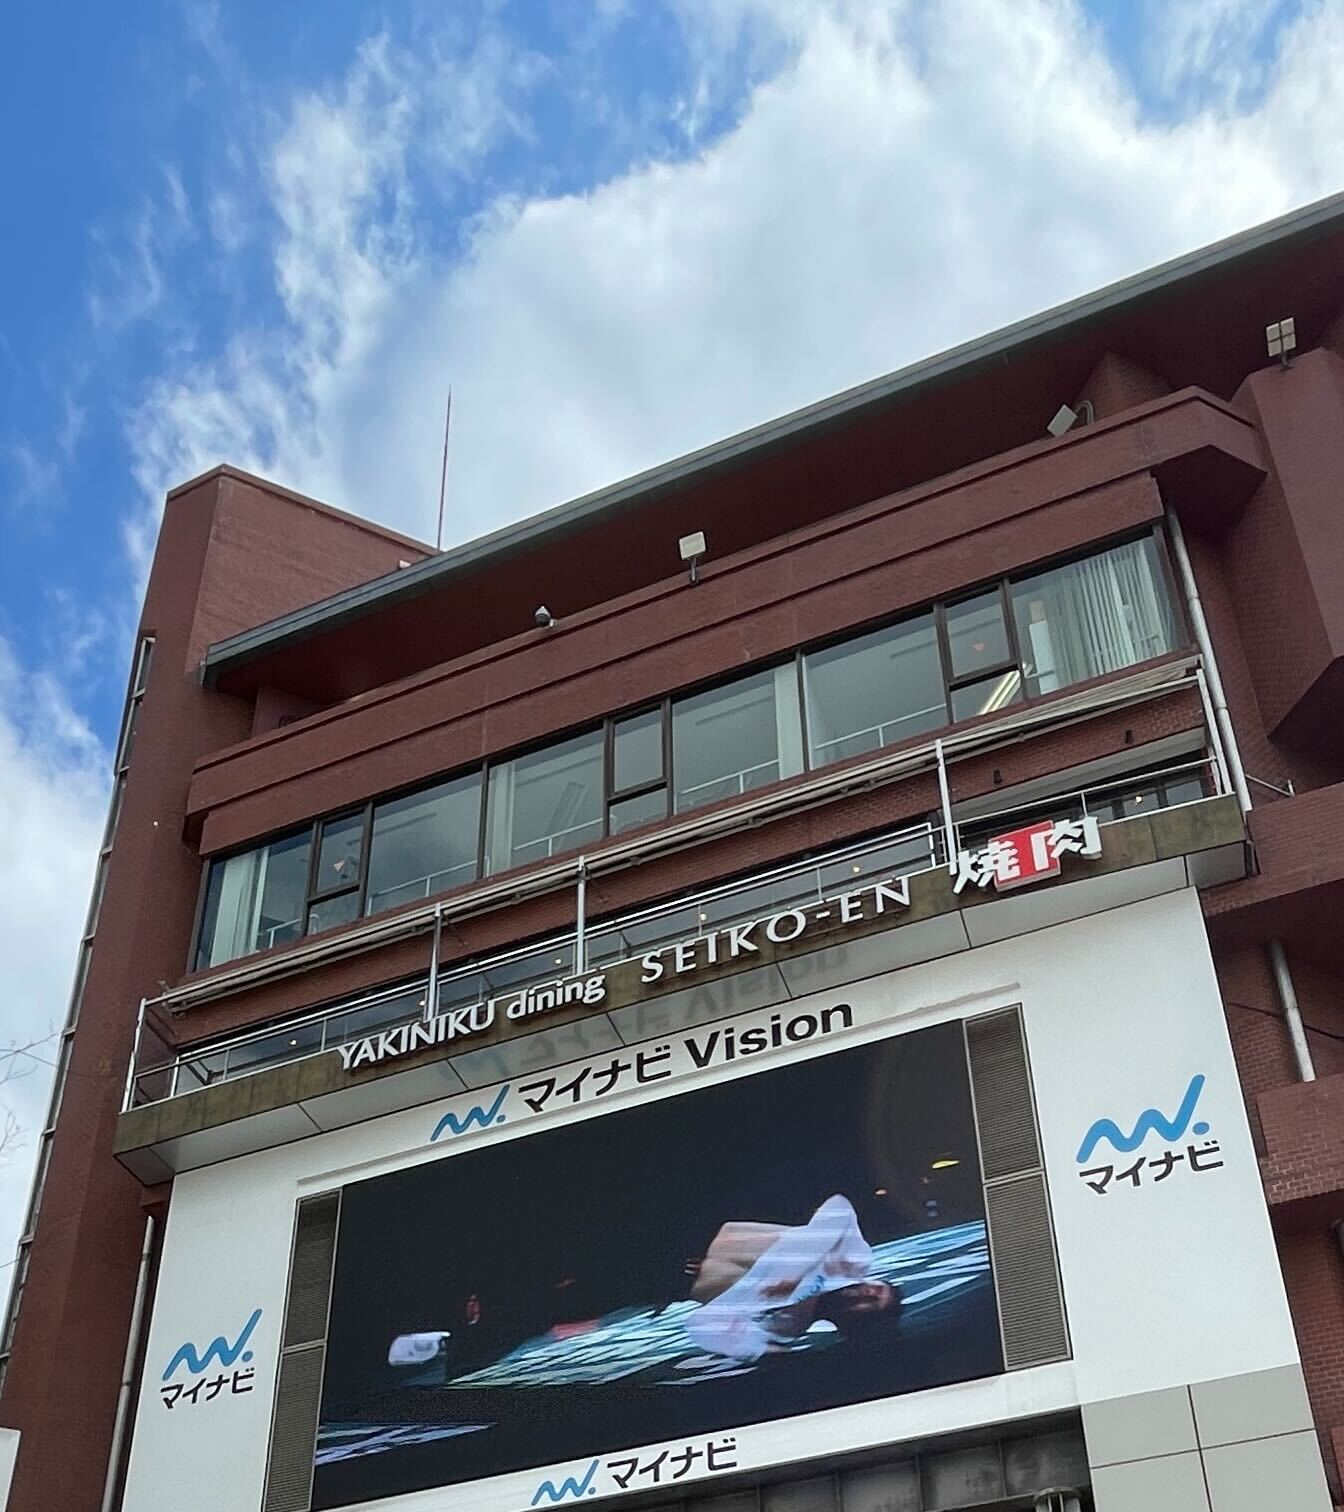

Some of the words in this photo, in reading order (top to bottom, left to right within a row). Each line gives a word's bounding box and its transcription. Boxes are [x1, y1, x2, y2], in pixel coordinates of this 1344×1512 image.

[953, 816, 1103, 894] 焼肉
[337, 1000, 495, 1070] YAKINIKU
[506, 975, 605, 1019] dining
[641, 877, 910, 982] SEIKO-EN
[518, 1045, 672, 1112] マイナビ
[685, 1003, 853, 1068] Vision
[1079, 1140, 1224, 1195] マイナビ
[160, 1368, 256, 1409] マイナビ
[607, 1437, 739, 1488] マイナビ
